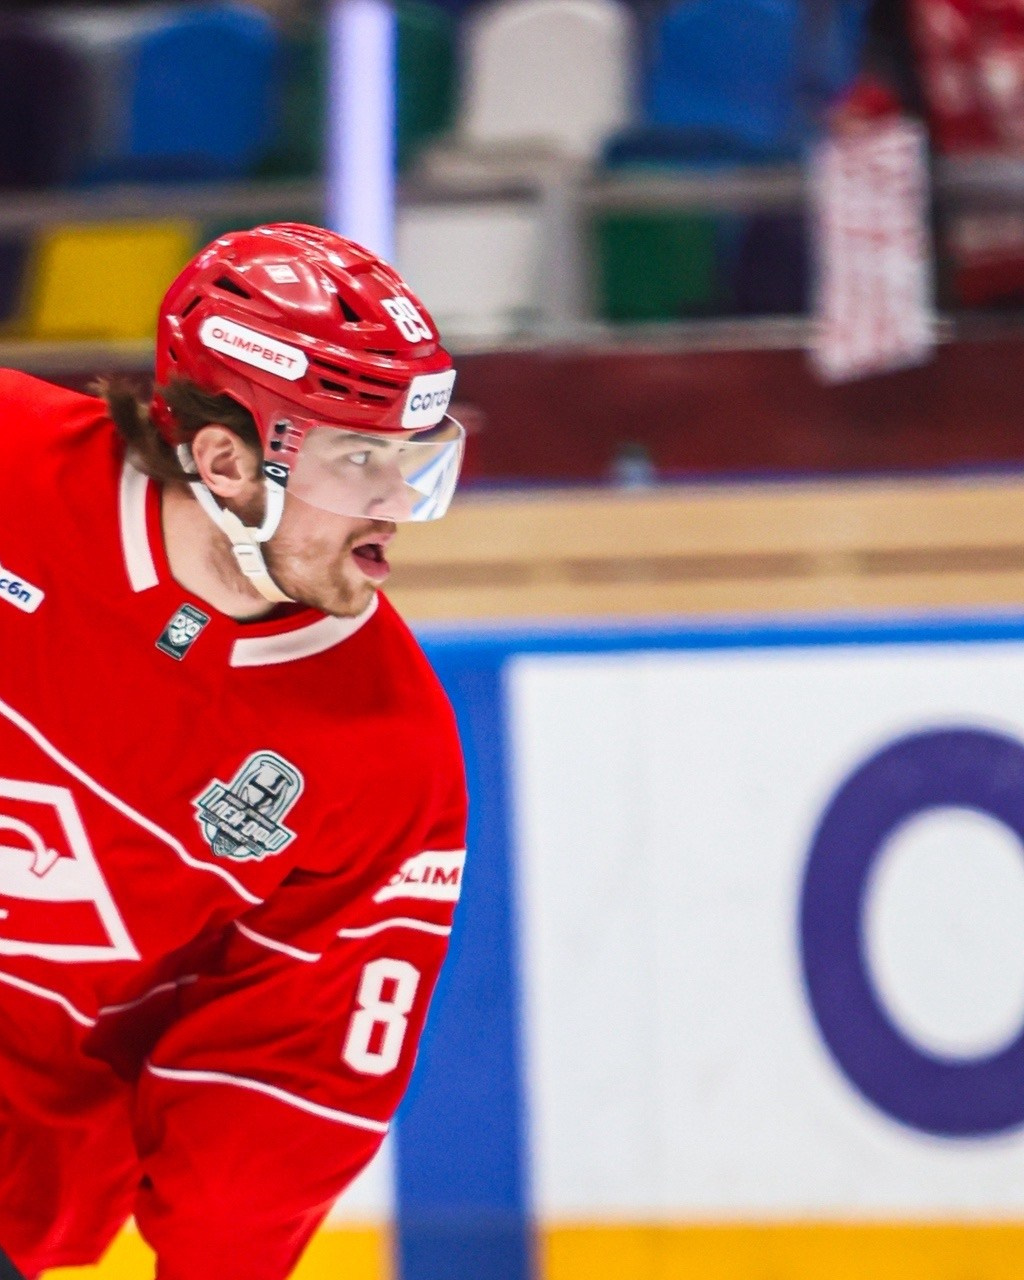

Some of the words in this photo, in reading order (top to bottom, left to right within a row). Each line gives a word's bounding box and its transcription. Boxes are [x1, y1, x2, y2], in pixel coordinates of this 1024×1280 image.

[380, 297, 433, 343] 89
[210, 326, 298, 370] OLIMPBET
[340, 957, 421, 1076] 8
